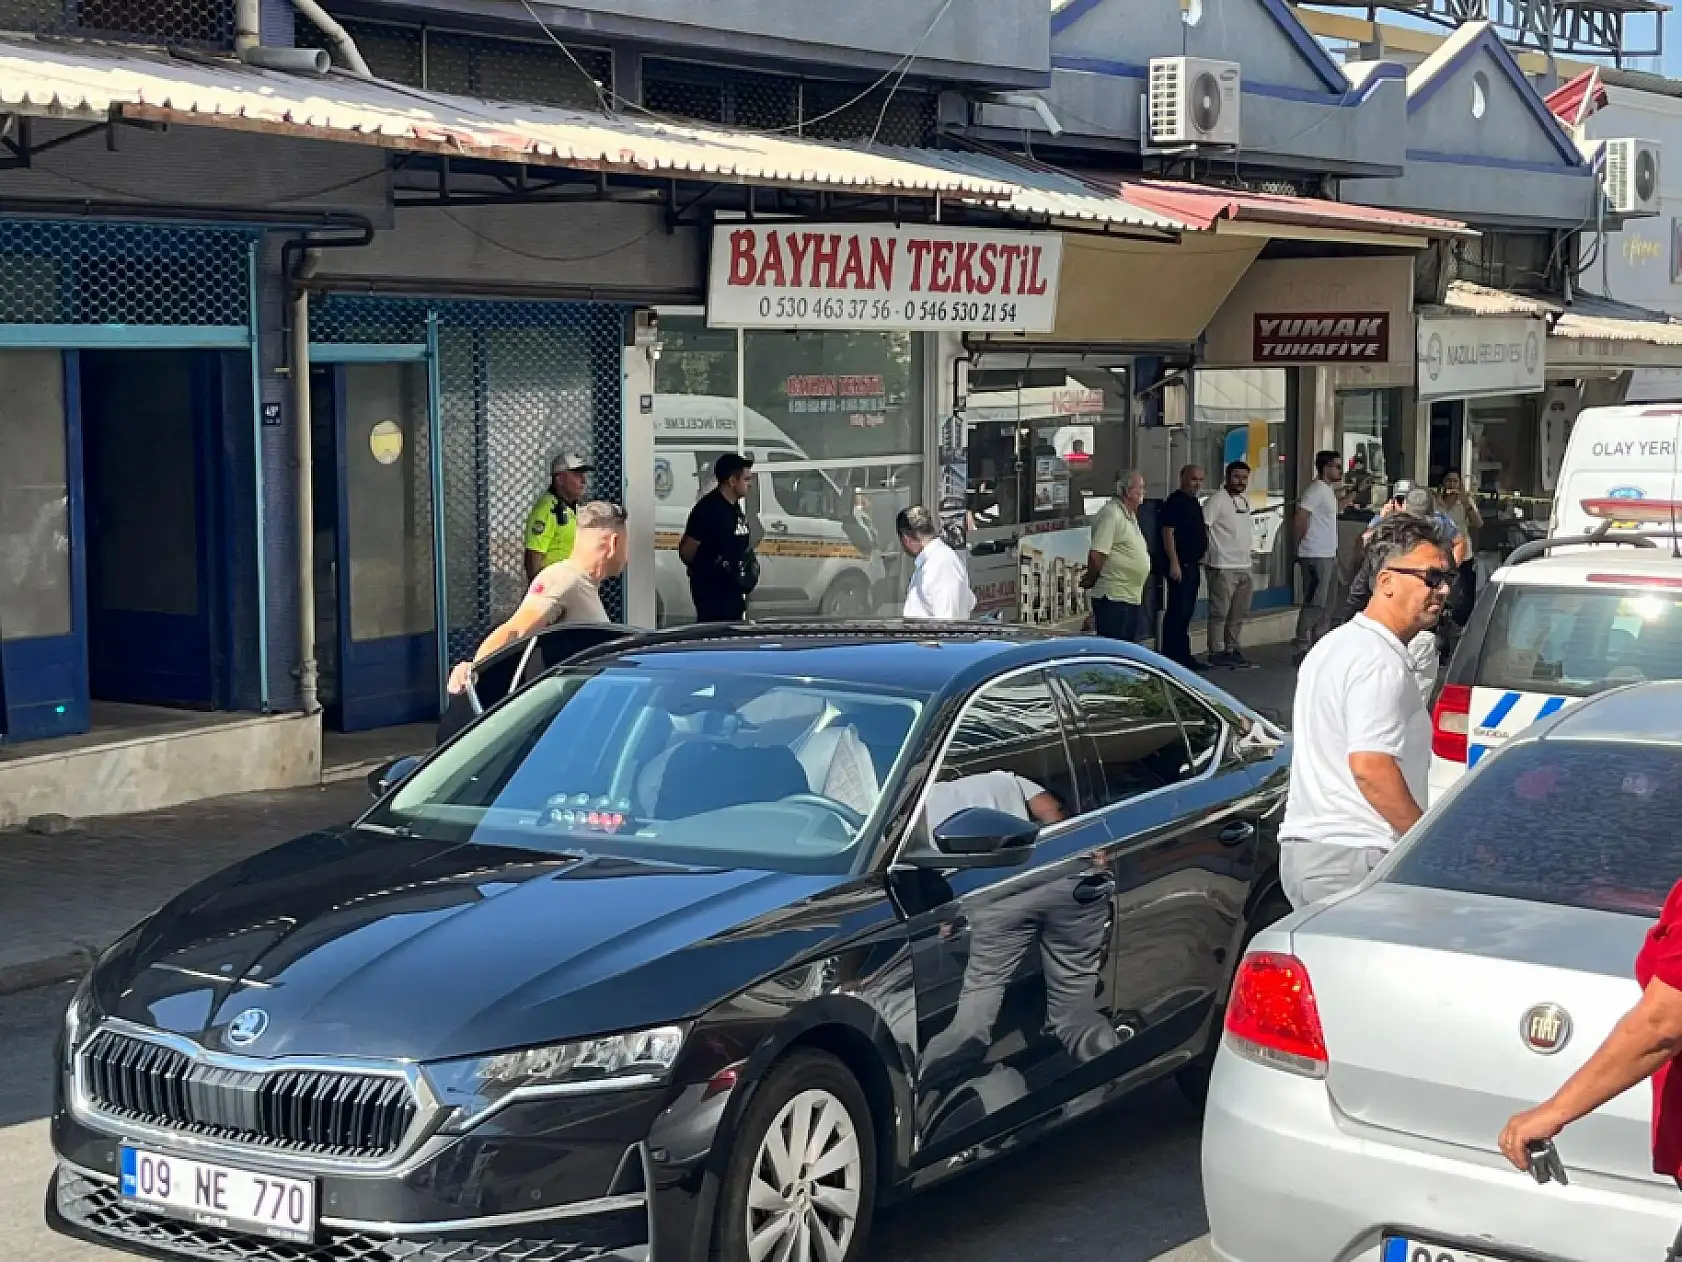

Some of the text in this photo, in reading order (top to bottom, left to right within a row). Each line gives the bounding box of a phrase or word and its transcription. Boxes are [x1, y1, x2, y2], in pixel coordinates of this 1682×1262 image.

[727, 228, 897, 291] BAYHAN
[759, 296, 771, 318] 0
[776, 297, 807, 319] 530
[812, 298, 844, 319] 463
[848, 299, 868, 320] 37
[871, 299, 890, 320] 56
[904, 301, 915, 321] 0
[919, 302, 947, 321] 546
[950, 302, 978, 322] 530
[981, 303, 996, 323] 21
[999, 303, 1017, 323] 54
[1260, 318, 1383, 337] YUMAK
[1261, 339, 1381, 356] TUHAFİYE
[1593, 441, 1634, 456] OLAY
[1531, 1016, 1562, 1042] FIAT
[140, 1157, 305, 1225] 09 NE 770
